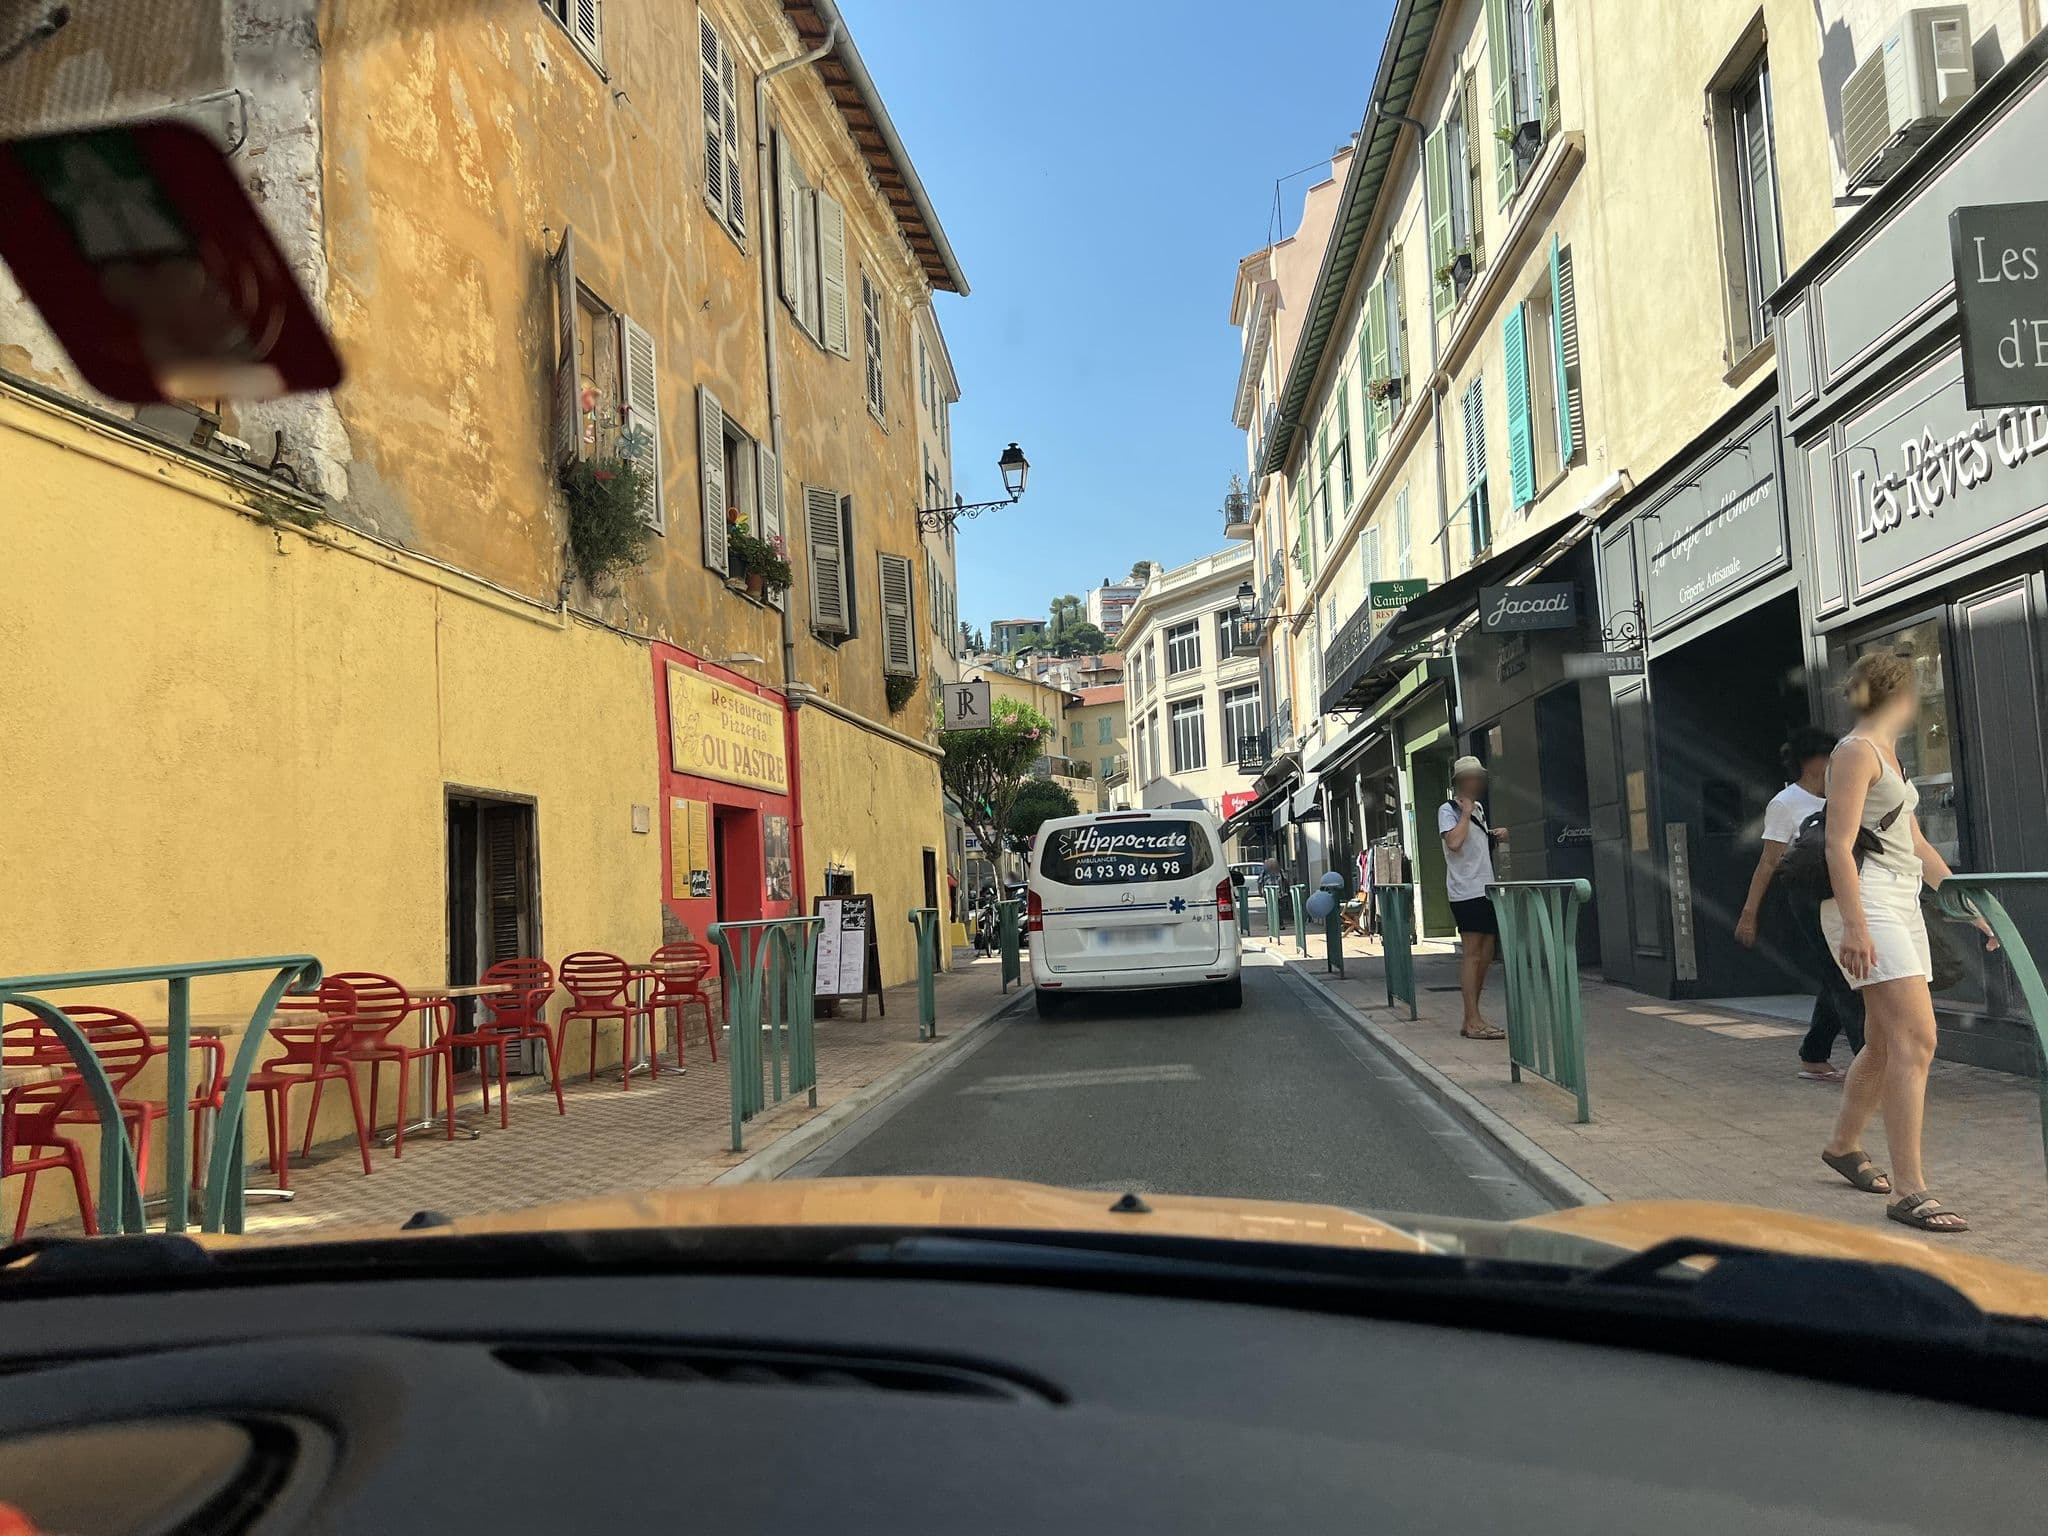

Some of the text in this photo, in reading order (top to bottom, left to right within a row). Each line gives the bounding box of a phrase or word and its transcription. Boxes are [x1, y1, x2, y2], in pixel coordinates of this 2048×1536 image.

[1973, 236, 2039, 283] Les
[1852, 468, 1901, 543] Les
[1901, 424, 1992, 518] Rêves
[1393, 583, 1404, 592] La
[1706, 557, 1741, 589] Artisanale
[1487, 592, 1570, 626] jacadi
[721, 712, 768, 743] Pizzeria
[702, 734, 785, 784] OU PASTRE
[1074, 826, 1187, 857] Hippocrate
[1074, 861, 1180, 880] 04 93 98 66 98
[1076, 856, 1117, 864] AMBULANCES
